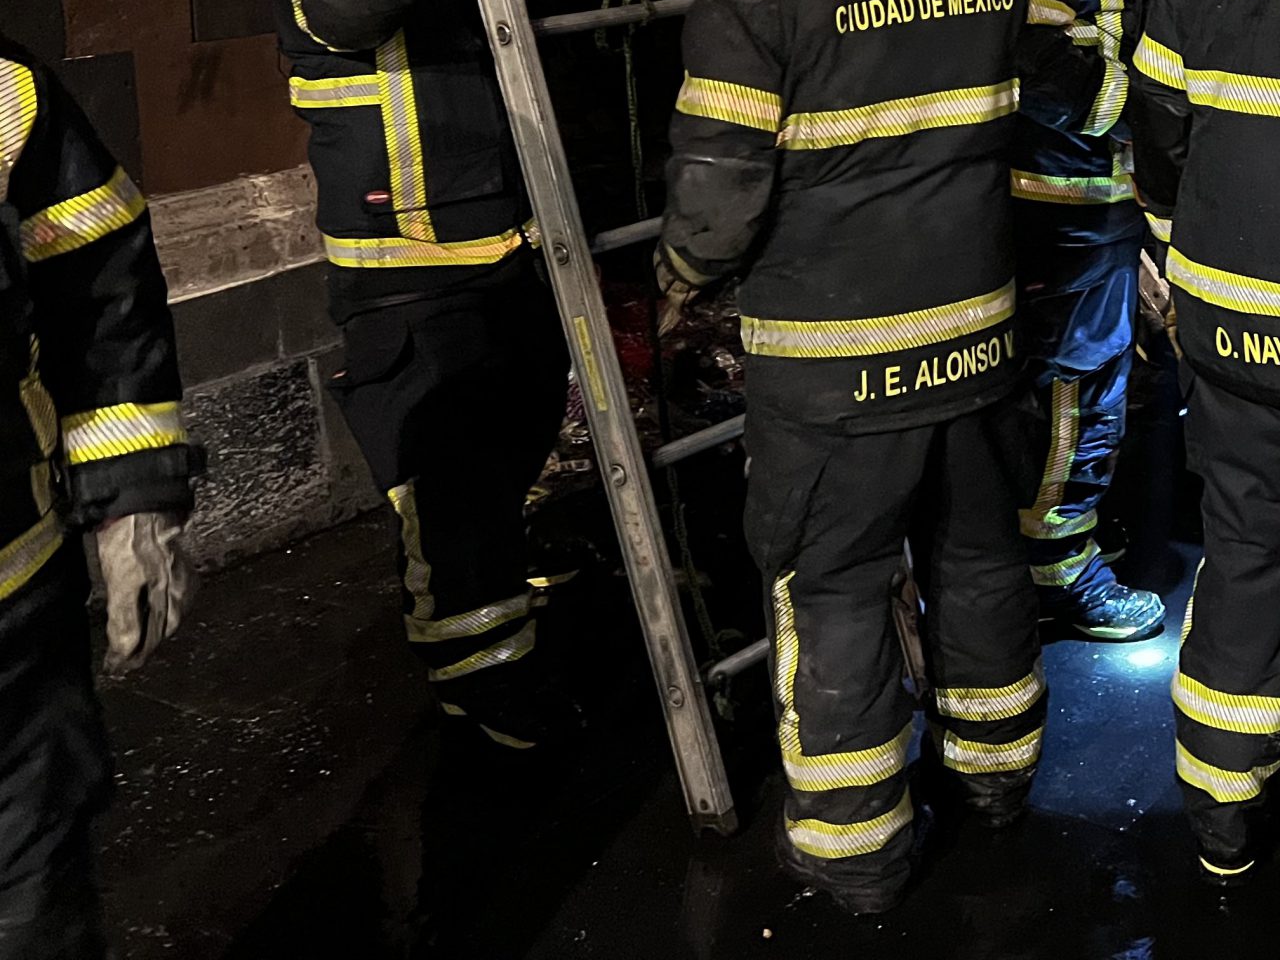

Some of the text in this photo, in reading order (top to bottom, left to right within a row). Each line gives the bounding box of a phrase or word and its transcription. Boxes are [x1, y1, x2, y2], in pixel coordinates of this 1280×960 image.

[1215, 326, 1239, 358] O.
[853, 370, 875, 402] J.
[885, 366, 907, 397] E.
[914, 337, 1001, 391] ALONSO
